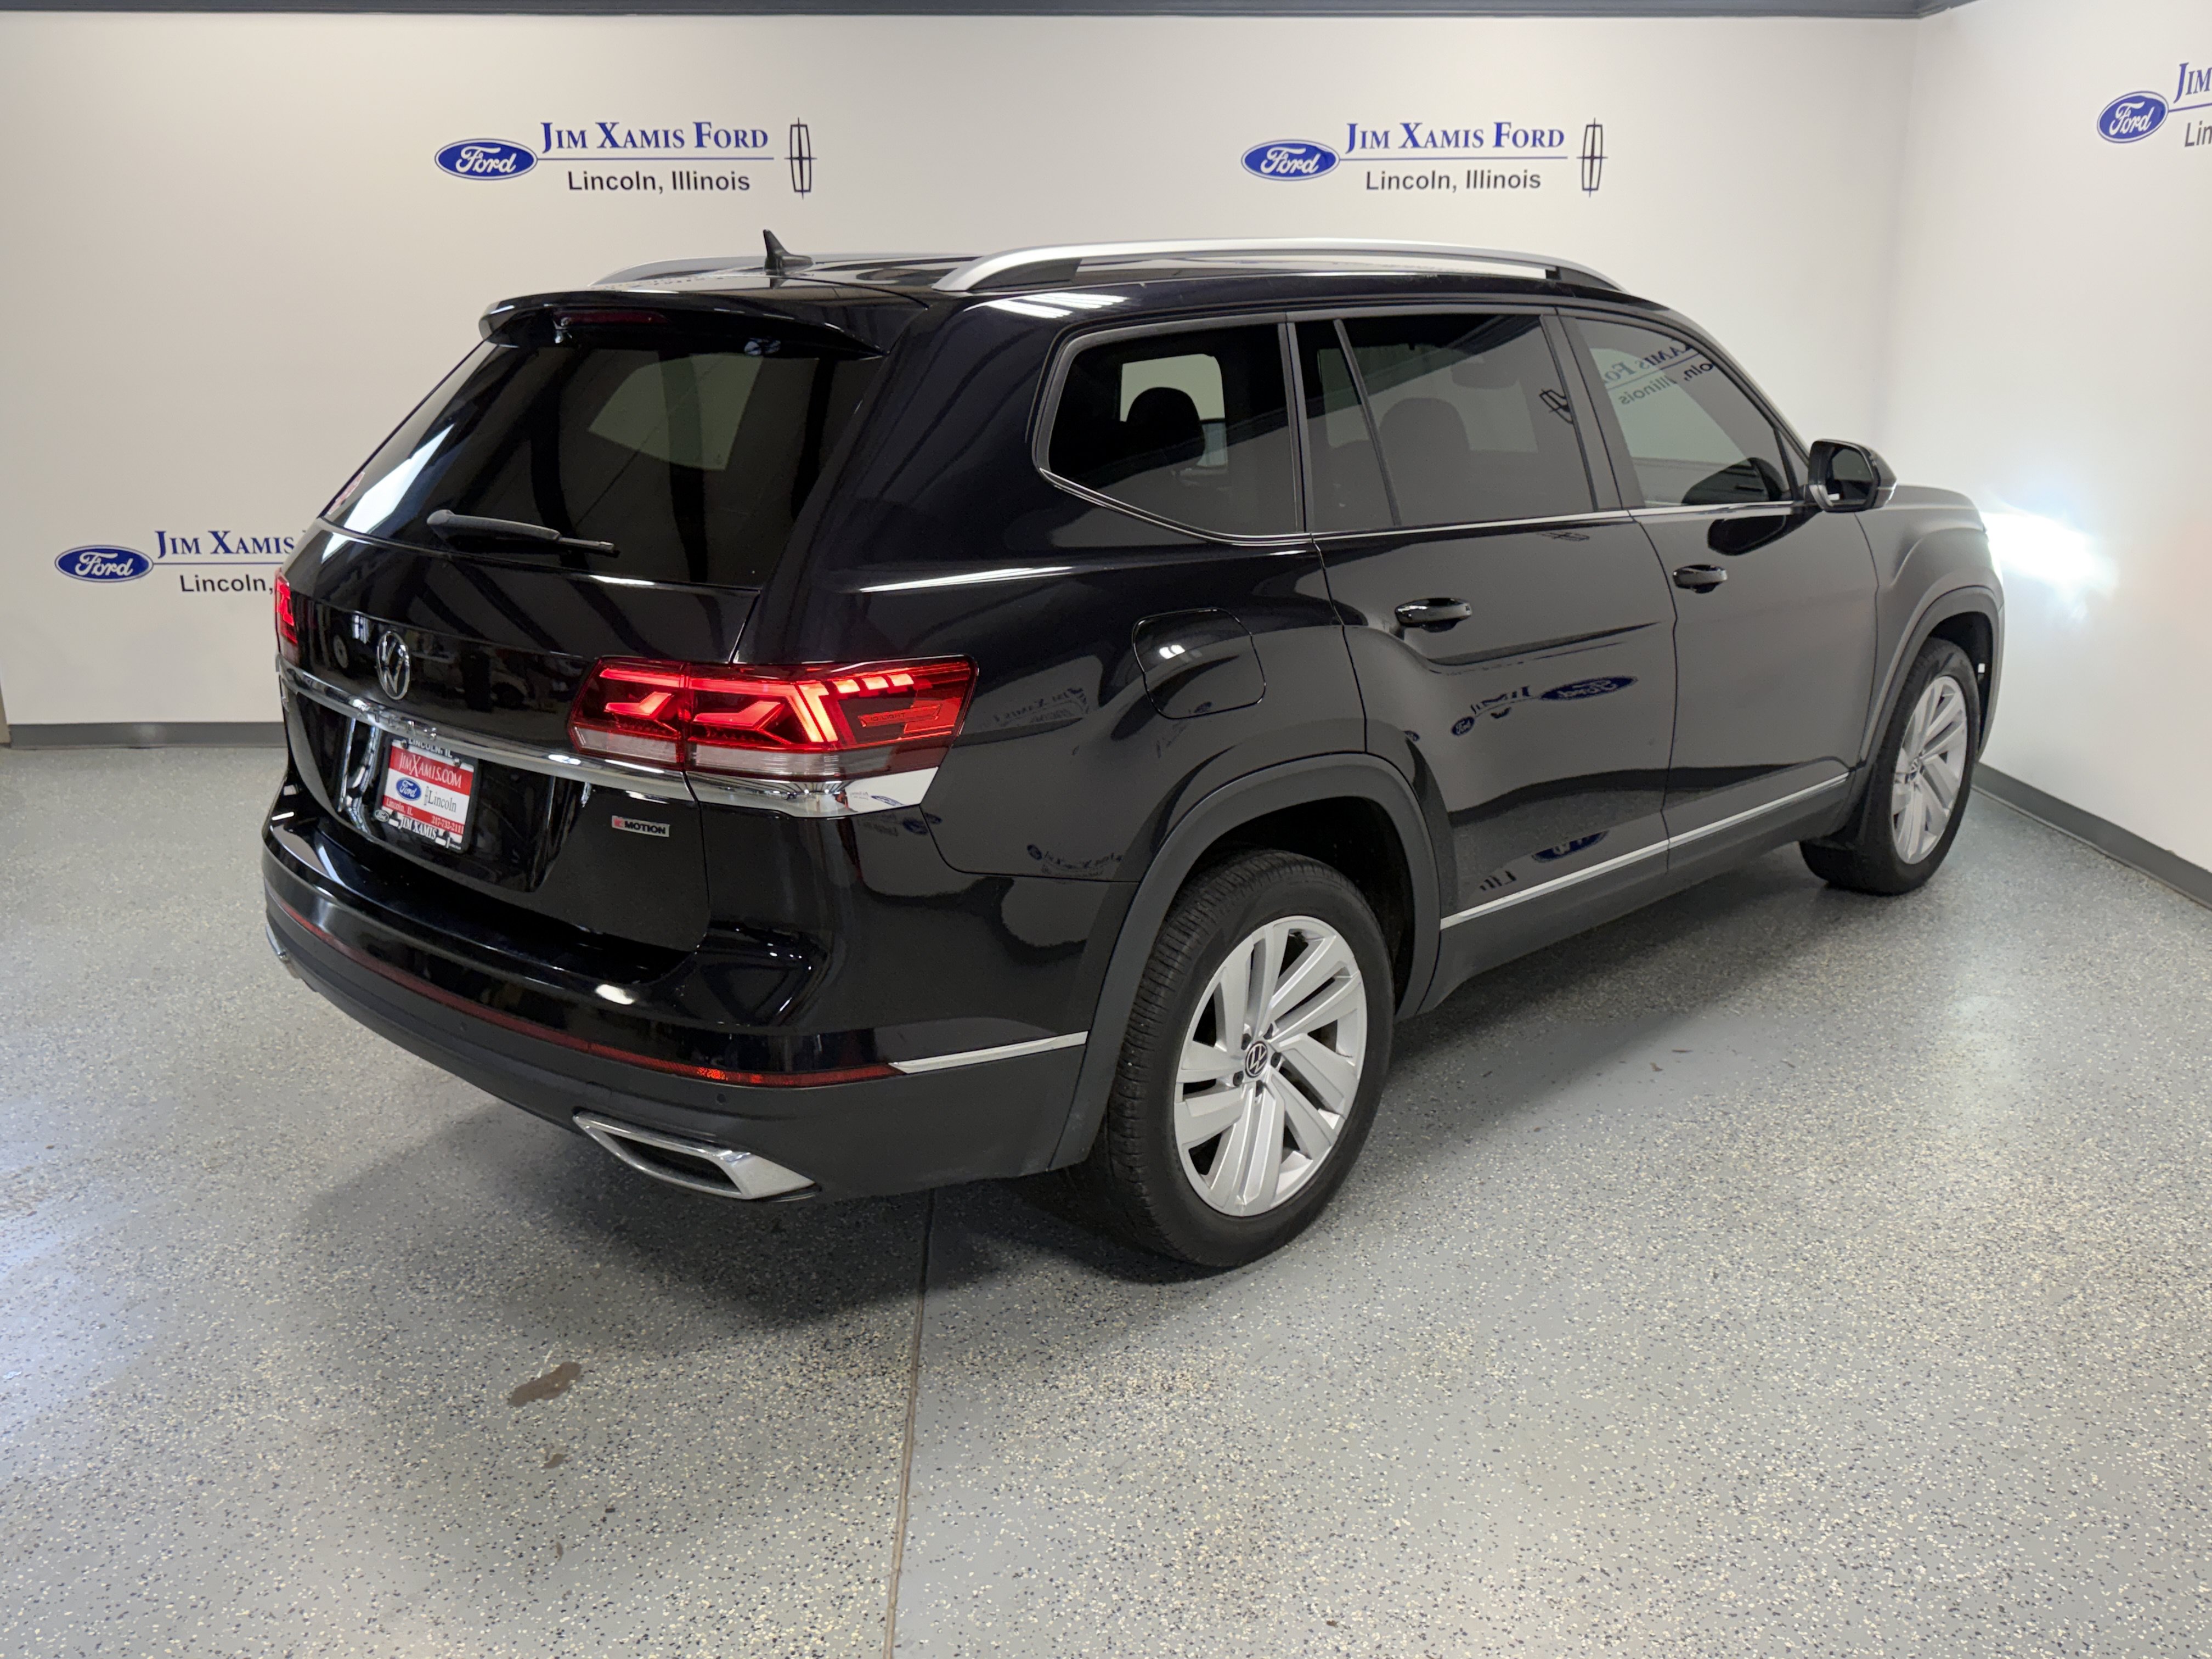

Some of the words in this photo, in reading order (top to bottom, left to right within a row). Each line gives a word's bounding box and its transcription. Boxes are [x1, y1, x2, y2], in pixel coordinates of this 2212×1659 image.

[2174, 62, 2212, 104] JIM
[2109, 101, 2155, 136] Ford
[540, 122, 588, 154] JIM
[595, 122, 686, 149] XAMIS
[692, 121, 769, 149] FORD
[1345, 123, 1391, 154] JIM
[1398, 122, 1485, 149] XAMIS
[1493, 121, 1565, 148] FORD
[455, 145, 517, 174] Ford
[1260, 147, 1320, 174] Ford
[567, 170, 664, 194] Lincoln,
[672, 170, 751, 191] Illinois
[1365, 171, 1458, 193] Lincoln,
[1465, 170, 1542, 190] Illinois
[154, 530, 202, 558] JIM
[207, 530, 295, 555] XAMIS
[75, 551, 133, 577] Ford
[179, 573, 273, 595] Lincoln,
[399, 752, 462, 788] JIMXAMIS.COM
[399, 780, 416, 797] Ford
[428, 790, 456, 812] Lincoln
[398, 816, 413, 830] JIM
[413, 821, 437, 840] XAMIS
